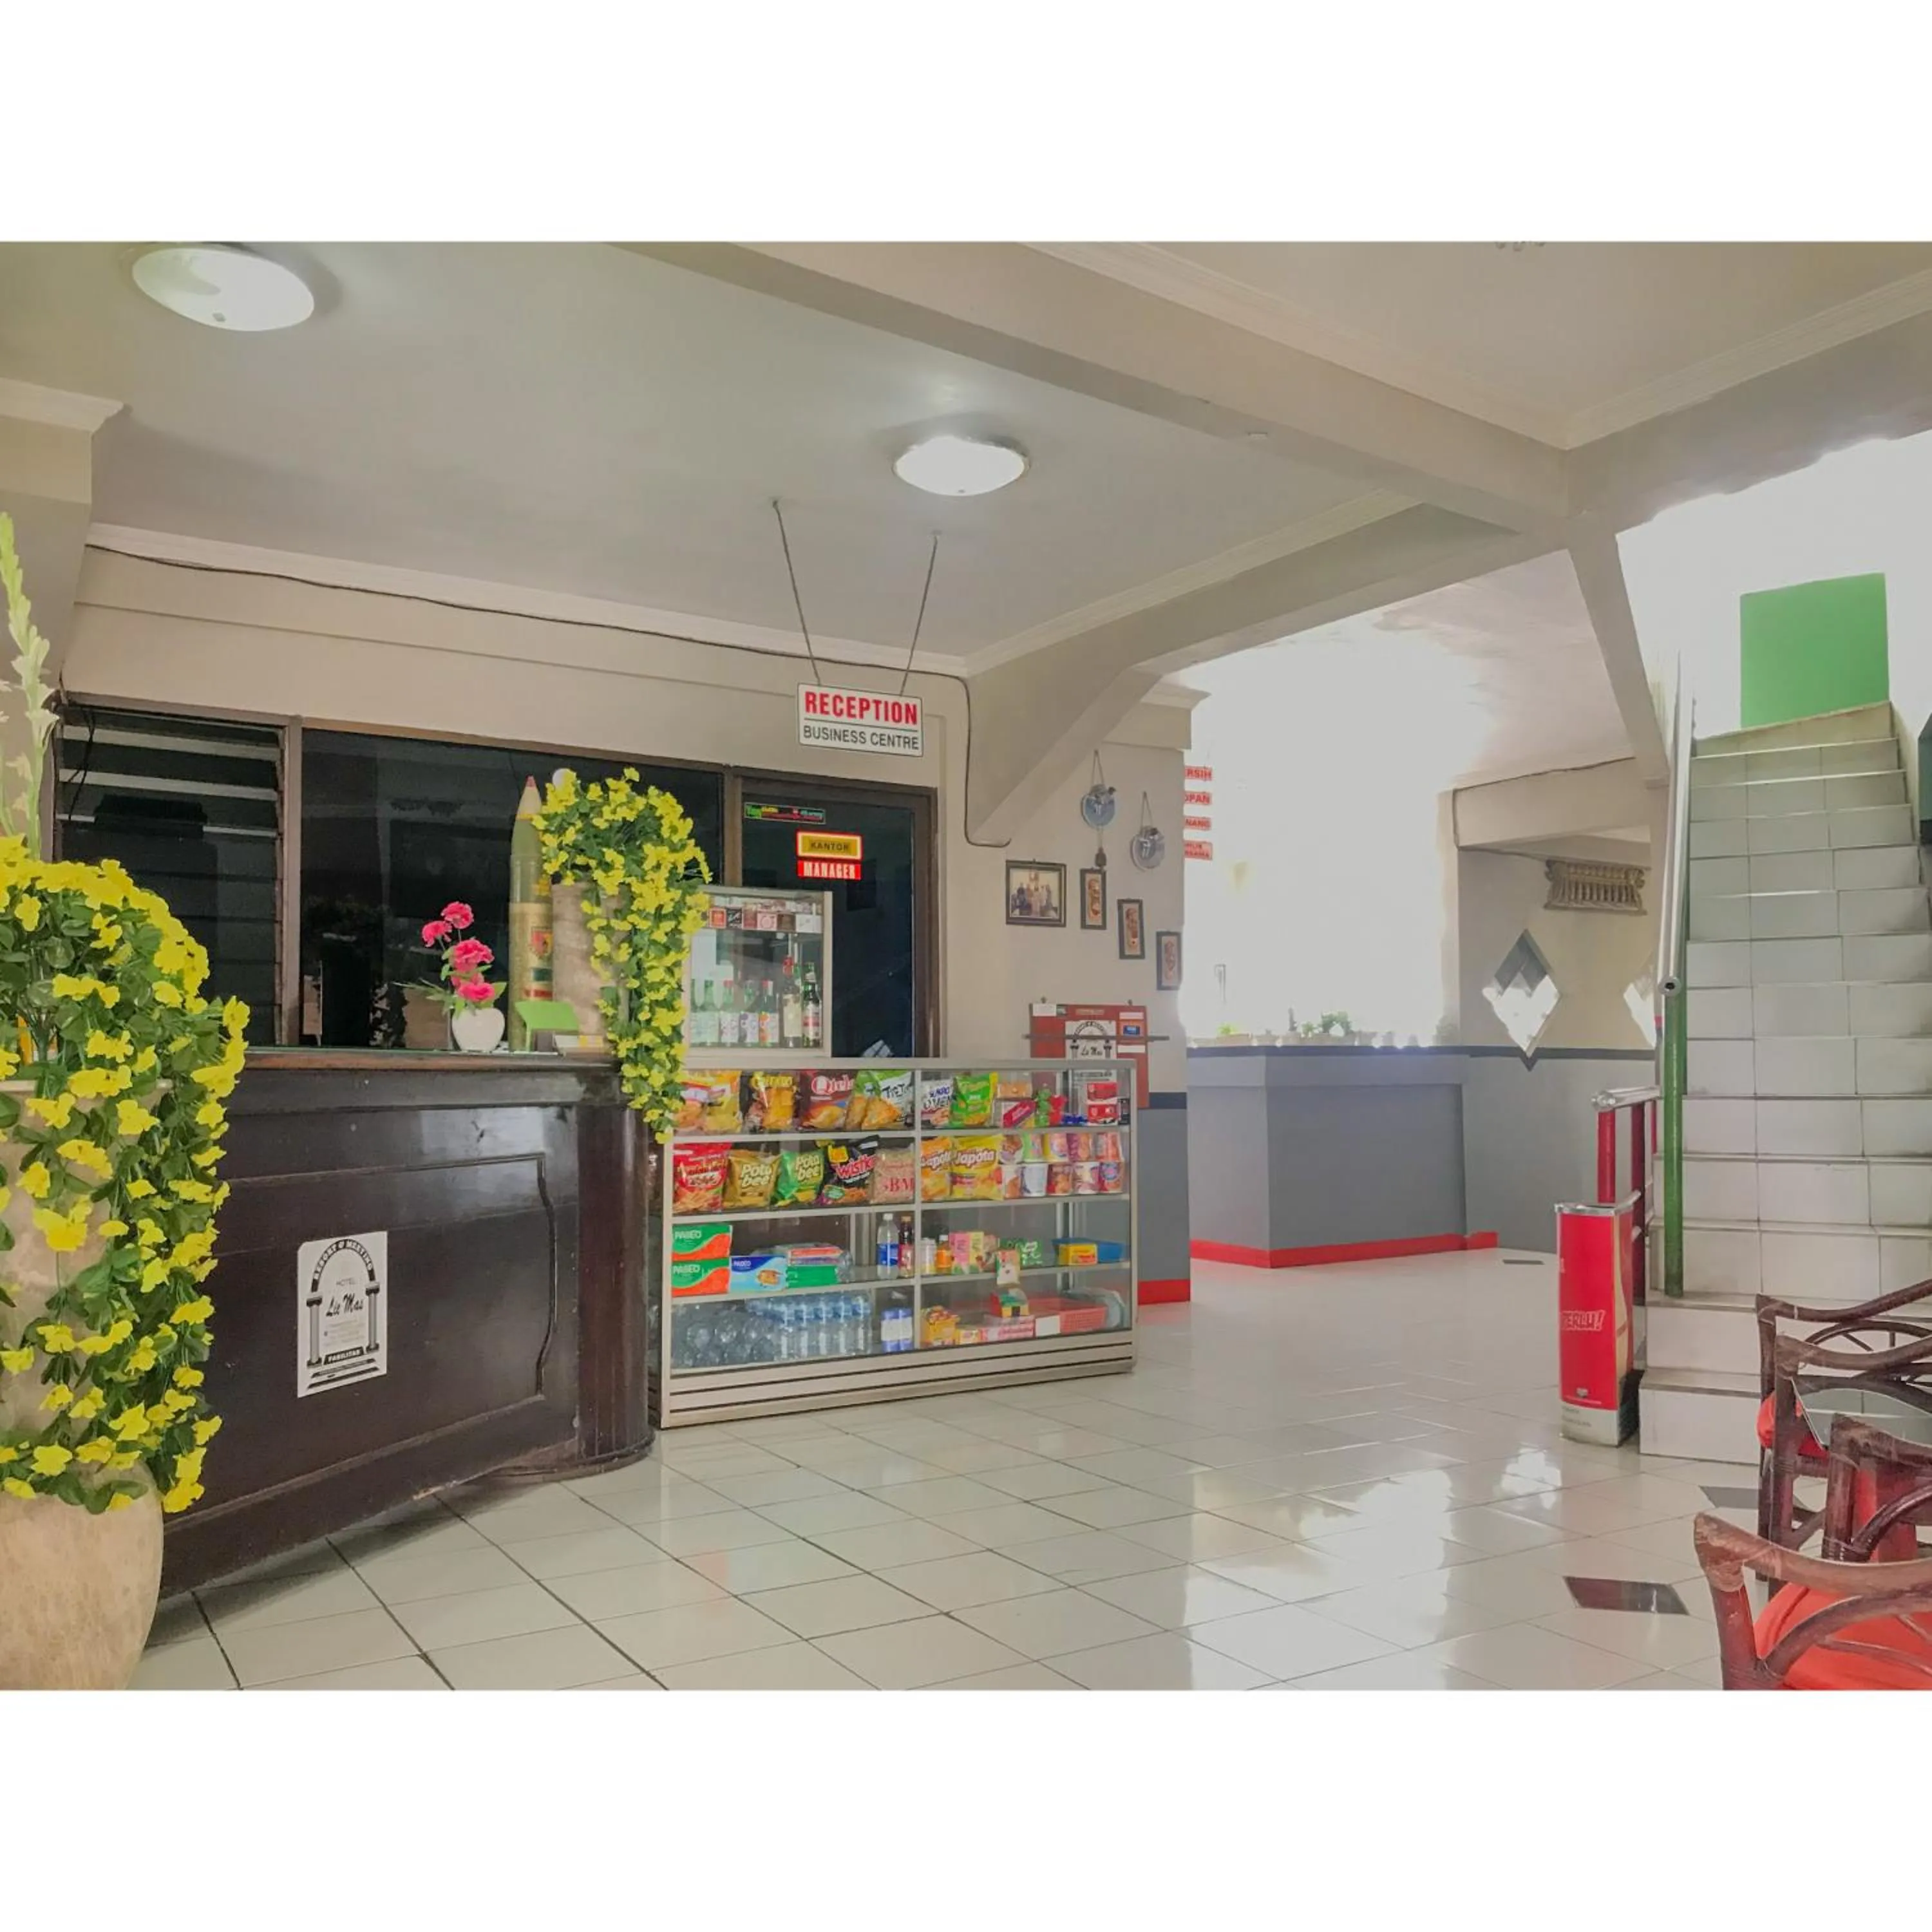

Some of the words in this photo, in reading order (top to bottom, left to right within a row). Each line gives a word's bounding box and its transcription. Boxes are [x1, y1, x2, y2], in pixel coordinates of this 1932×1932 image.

[804, 691, 918, 725] RECEPTION
[803, 725, 867, 744] BUSINESS
[869, 732, 920, 750] CENTRE
[1185, 768, 1212, 780] RSIH
[810, 841, 851, 852] KANTOR
[803, 860, 856, 880] MANAGER
